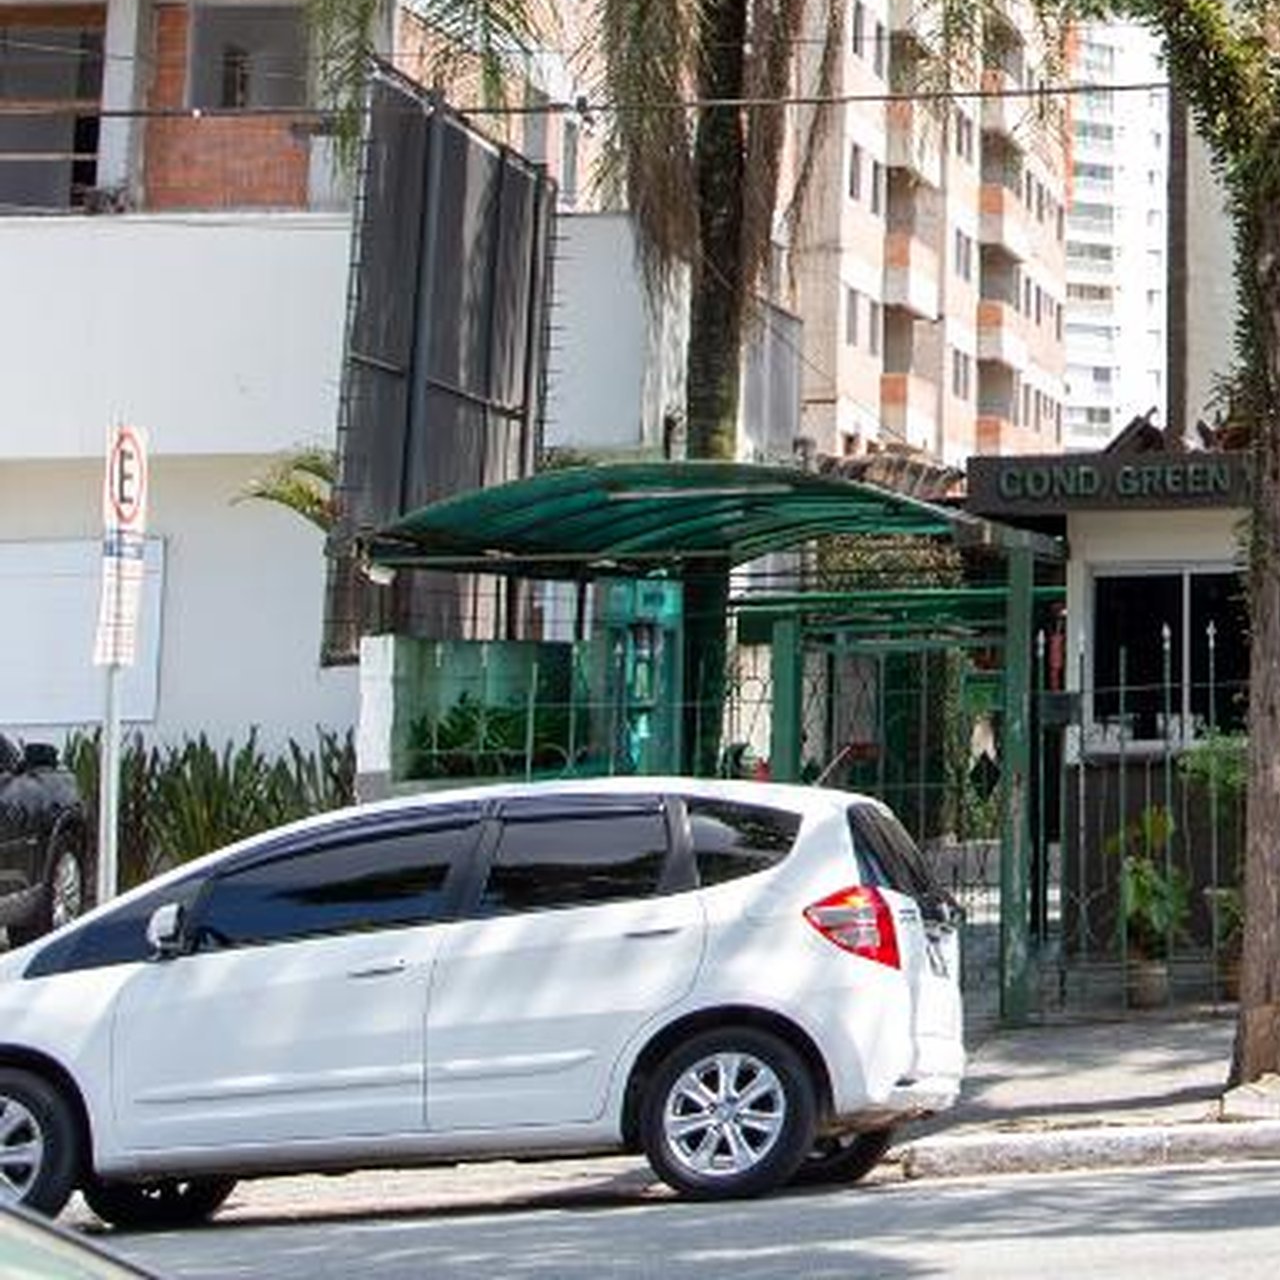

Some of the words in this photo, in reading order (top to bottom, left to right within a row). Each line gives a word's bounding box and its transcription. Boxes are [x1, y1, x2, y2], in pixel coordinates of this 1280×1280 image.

[119, 449, 134, 504] E
[1001, 466, 1100, 496] COND
[1118, 463, 1229, 494] GREEN
